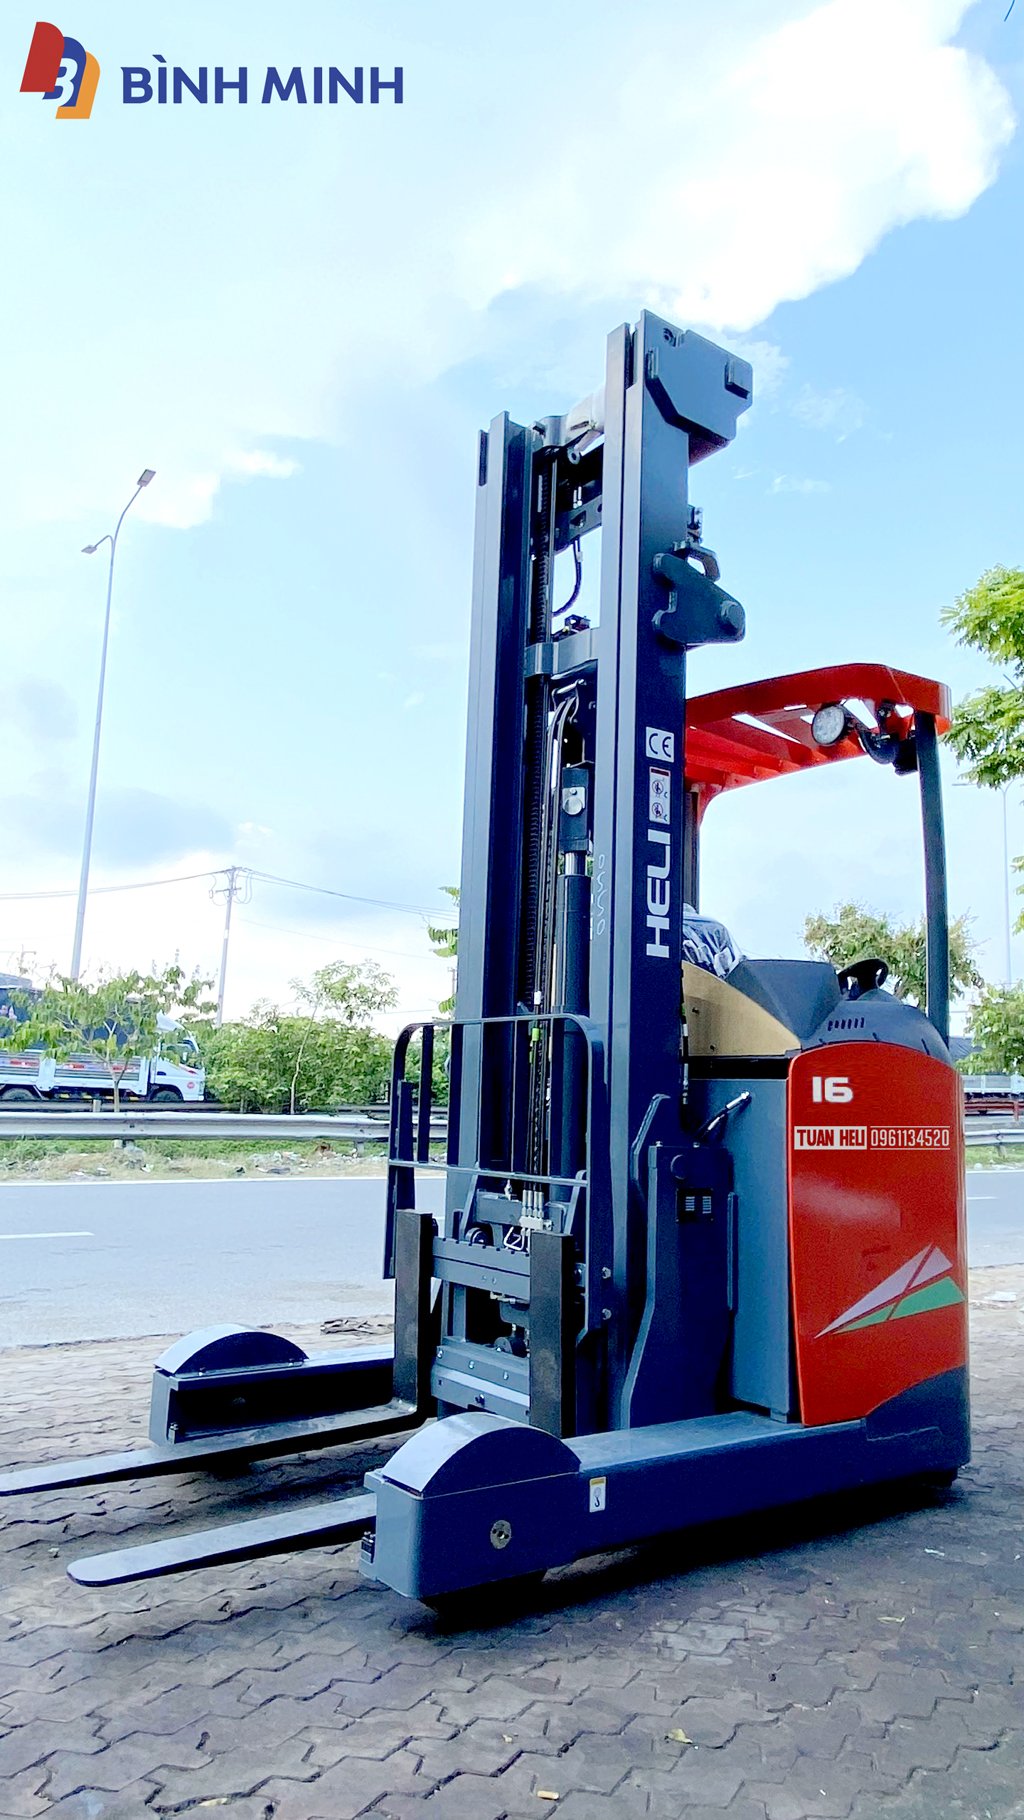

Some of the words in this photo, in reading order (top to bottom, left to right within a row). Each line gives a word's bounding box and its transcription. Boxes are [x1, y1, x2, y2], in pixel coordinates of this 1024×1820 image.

[648, 732, 672, 758] CE
[646, 828, 671, 958] HELI
[812, 1076, 854, 1103] 16
[796, 1129, 834, 1147] TUAN
[839, 1129, 865, 1147] HELI
[870, 1128, 950, 1147] 0961134520
